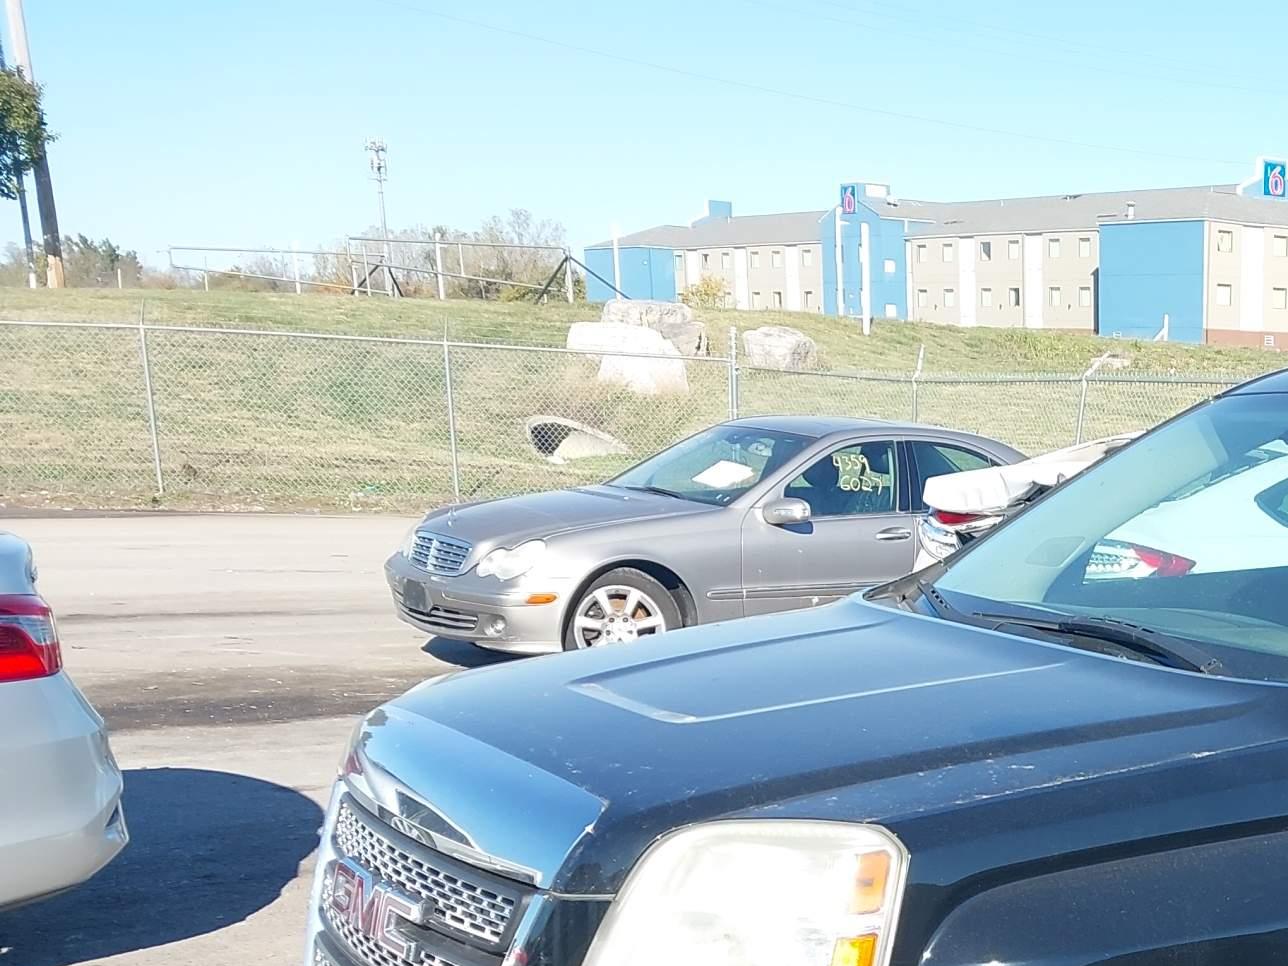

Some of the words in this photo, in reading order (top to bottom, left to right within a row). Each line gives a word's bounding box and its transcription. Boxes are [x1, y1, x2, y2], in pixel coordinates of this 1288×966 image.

[832, 454, 870, 473] 4359
[840, 475, 882, 496] 6027
[330, 858, 424, 960] GMC
